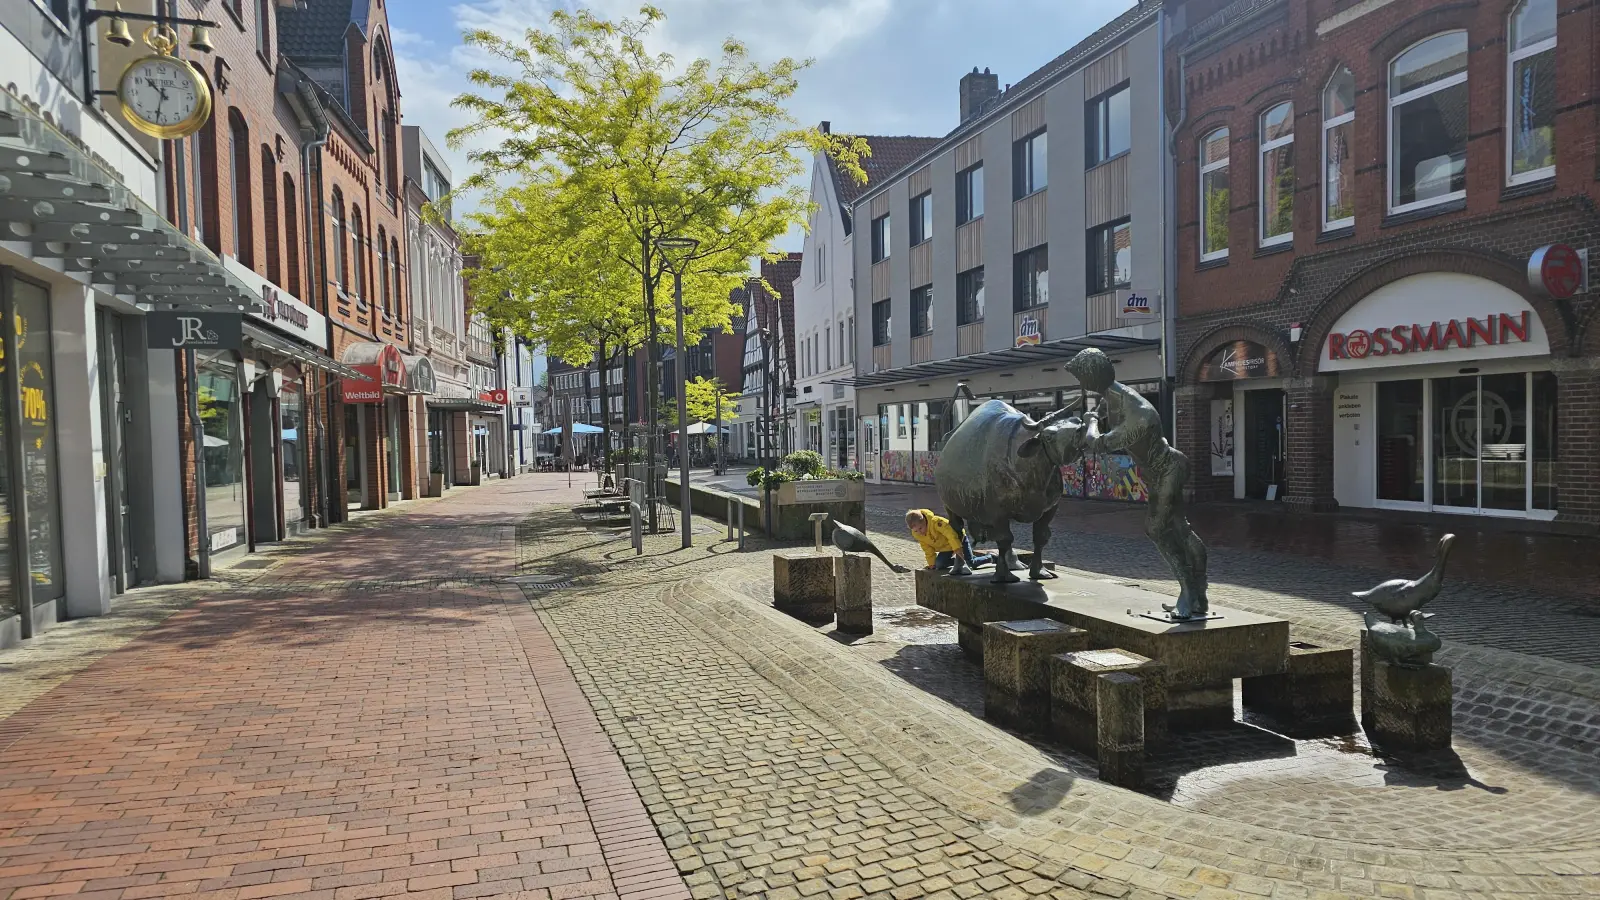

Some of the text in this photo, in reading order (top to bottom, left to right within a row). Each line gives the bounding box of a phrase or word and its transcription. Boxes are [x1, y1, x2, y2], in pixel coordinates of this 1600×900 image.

[1128, 294, 1148, 306] dm
[172, 316, 207, 346] JR
[1020, 317, 1037, 336] dm
[1329, 311, 1528, 360] ROSSMANN
[344, 392, 380, 400] Weltbild
